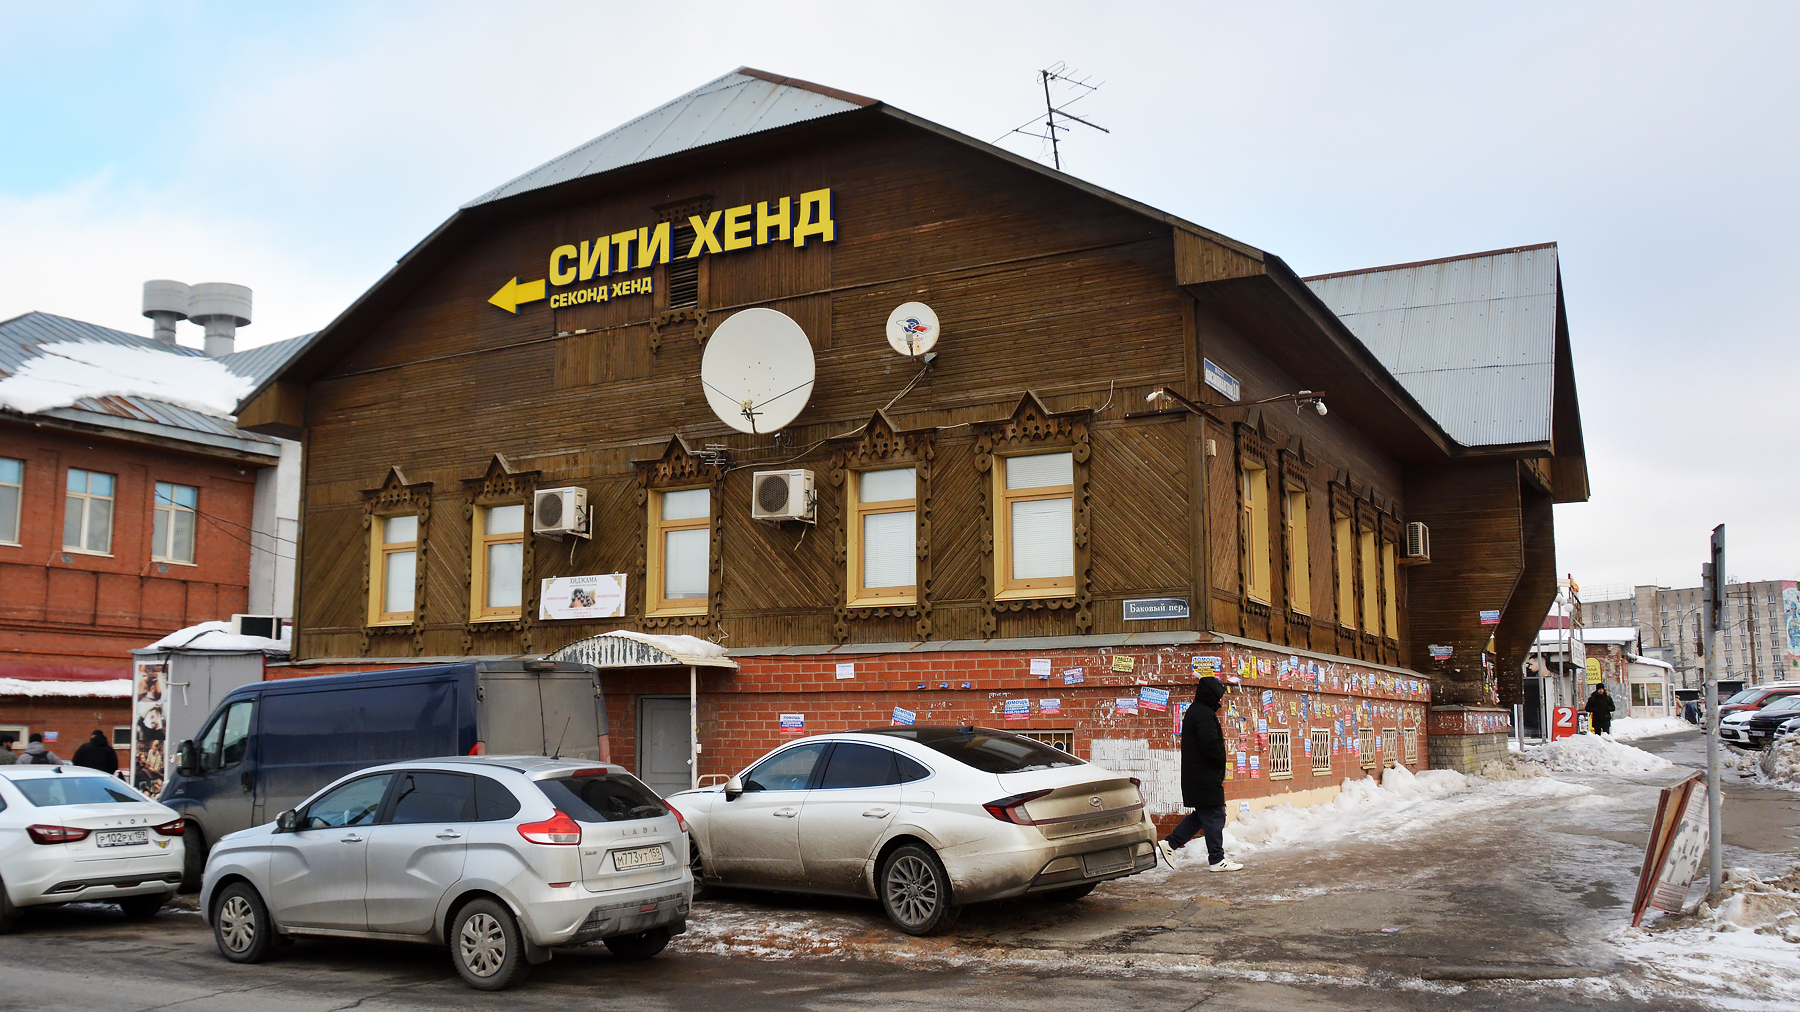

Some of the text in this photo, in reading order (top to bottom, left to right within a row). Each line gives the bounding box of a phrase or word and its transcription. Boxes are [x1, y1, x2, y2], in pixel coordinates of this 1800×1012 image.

[549, 187, 836, 287] СИТИ ХЕНД
[549, 276, 654, 309] СЕКОНД ХЕНД
[1130, 603, 1186, 613] Баковый пер.
[1142, 687, 1168, 695] ПОМОЩЬ
[1557, 708, 1573, 728] 2
[622, 827, 657, 836] LADA
[617, 847, 660, 865] М773УТ 159
